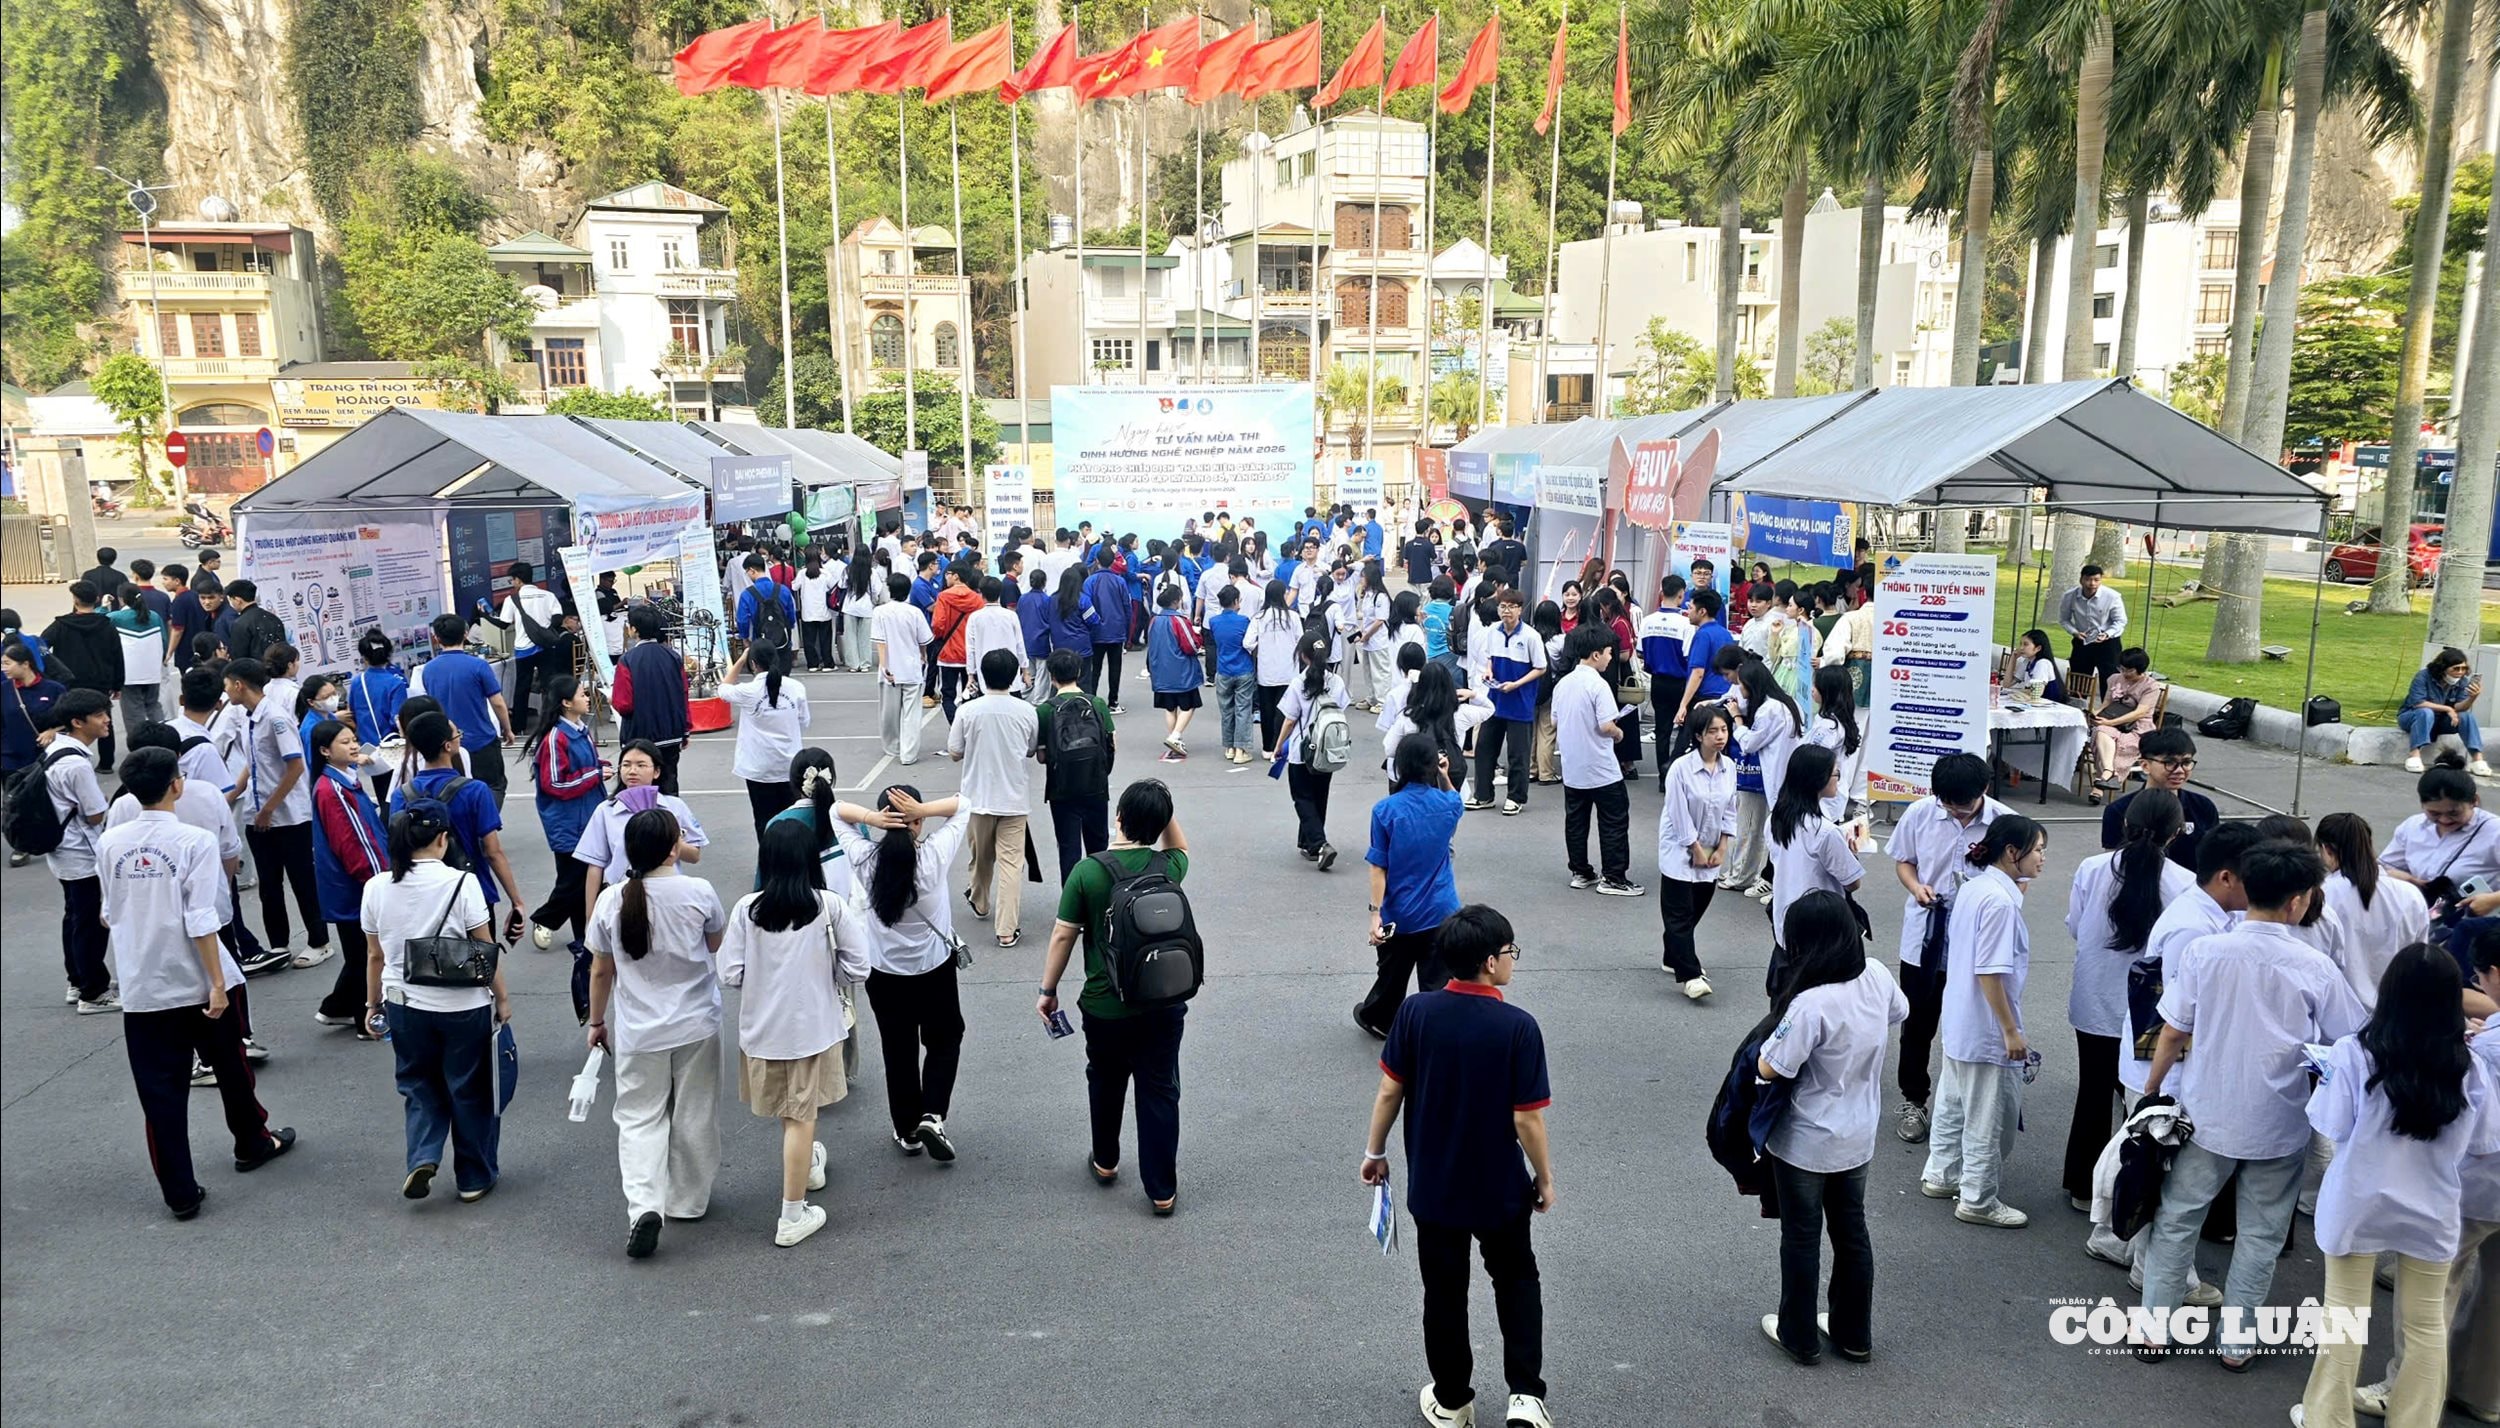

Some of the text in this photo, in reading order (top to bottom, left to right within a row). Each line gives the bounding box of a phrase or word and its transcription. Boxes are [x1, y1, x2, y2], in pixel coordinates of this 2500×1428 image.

[336, 394, 421, 404] HOÀNG GIA
[1156, 431, 1260, 445] TƯ VẤN MÙA THI
[1110, 448, 1148, 458] HƯỚNG
[1184, 446, 1224, 458] NGHIỆP
[1256, 446, 1286, 454] 2026
[1271, 462, 1296, 471] NINH
[1638, 450, 1674, 487] BUV
[1750, 510, 1831, 535] TRƯỜNG ĐẠI HỌC HẠ LONG
[1766, 532, 1775, 544] Học
[1796, 538, 1808, 549] công
[1882, 580, 1985, 596] THÔNG TIN TUYỂN SINH
[1920, 595, 1946, 605] 2026
[1882, 620, 1908, 636] 26
[1890, 668, 1910, 680] 03
[1874, 780, 1886, 790] CHẤT
[1888, 784, 1906, 794] LƯỢNG
[1912, 784, 1927, 795] SÁNG
